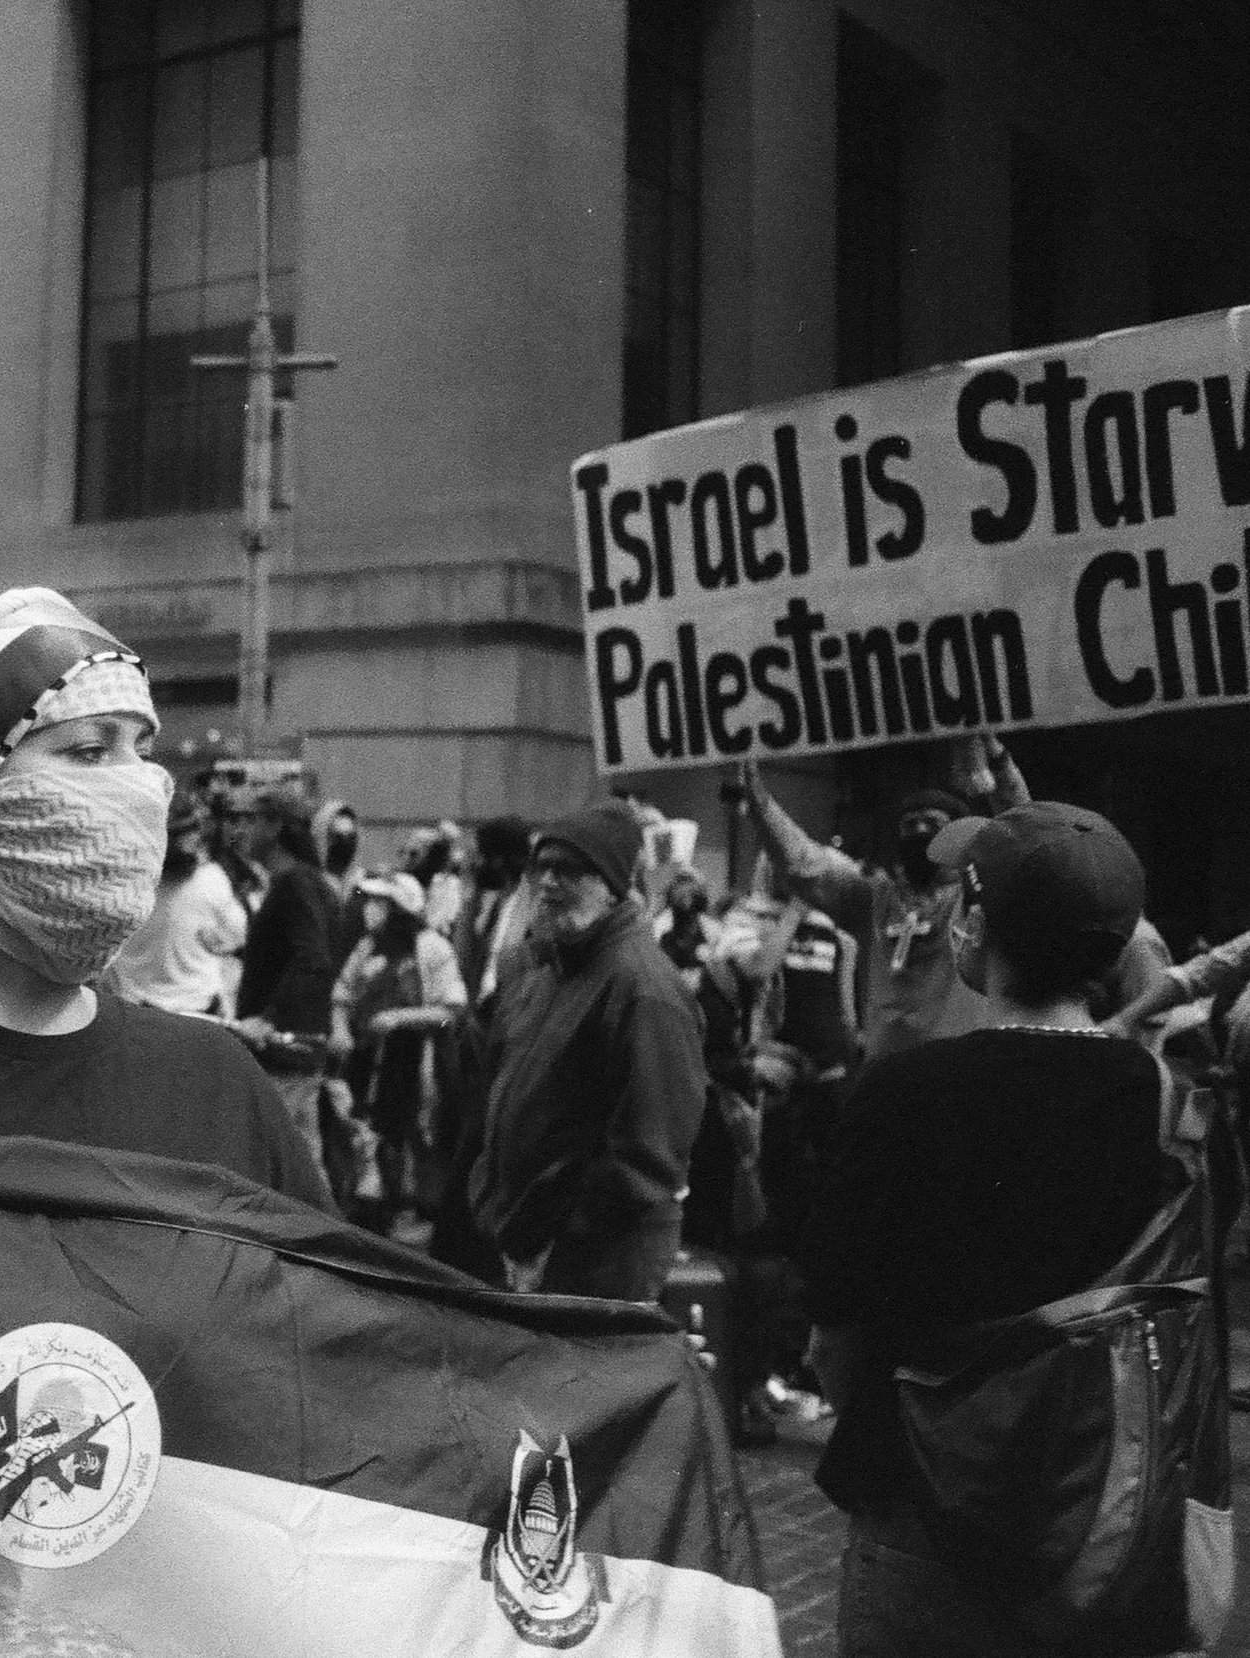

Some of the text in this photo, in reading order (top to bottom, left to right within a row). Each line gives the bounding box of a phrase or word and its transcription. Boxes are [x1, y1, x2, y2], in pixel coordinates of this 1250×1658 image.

[576, 359, 1250, 612] Israel is Starv
[596, 528, 1250, 765] Palestinian Chi
